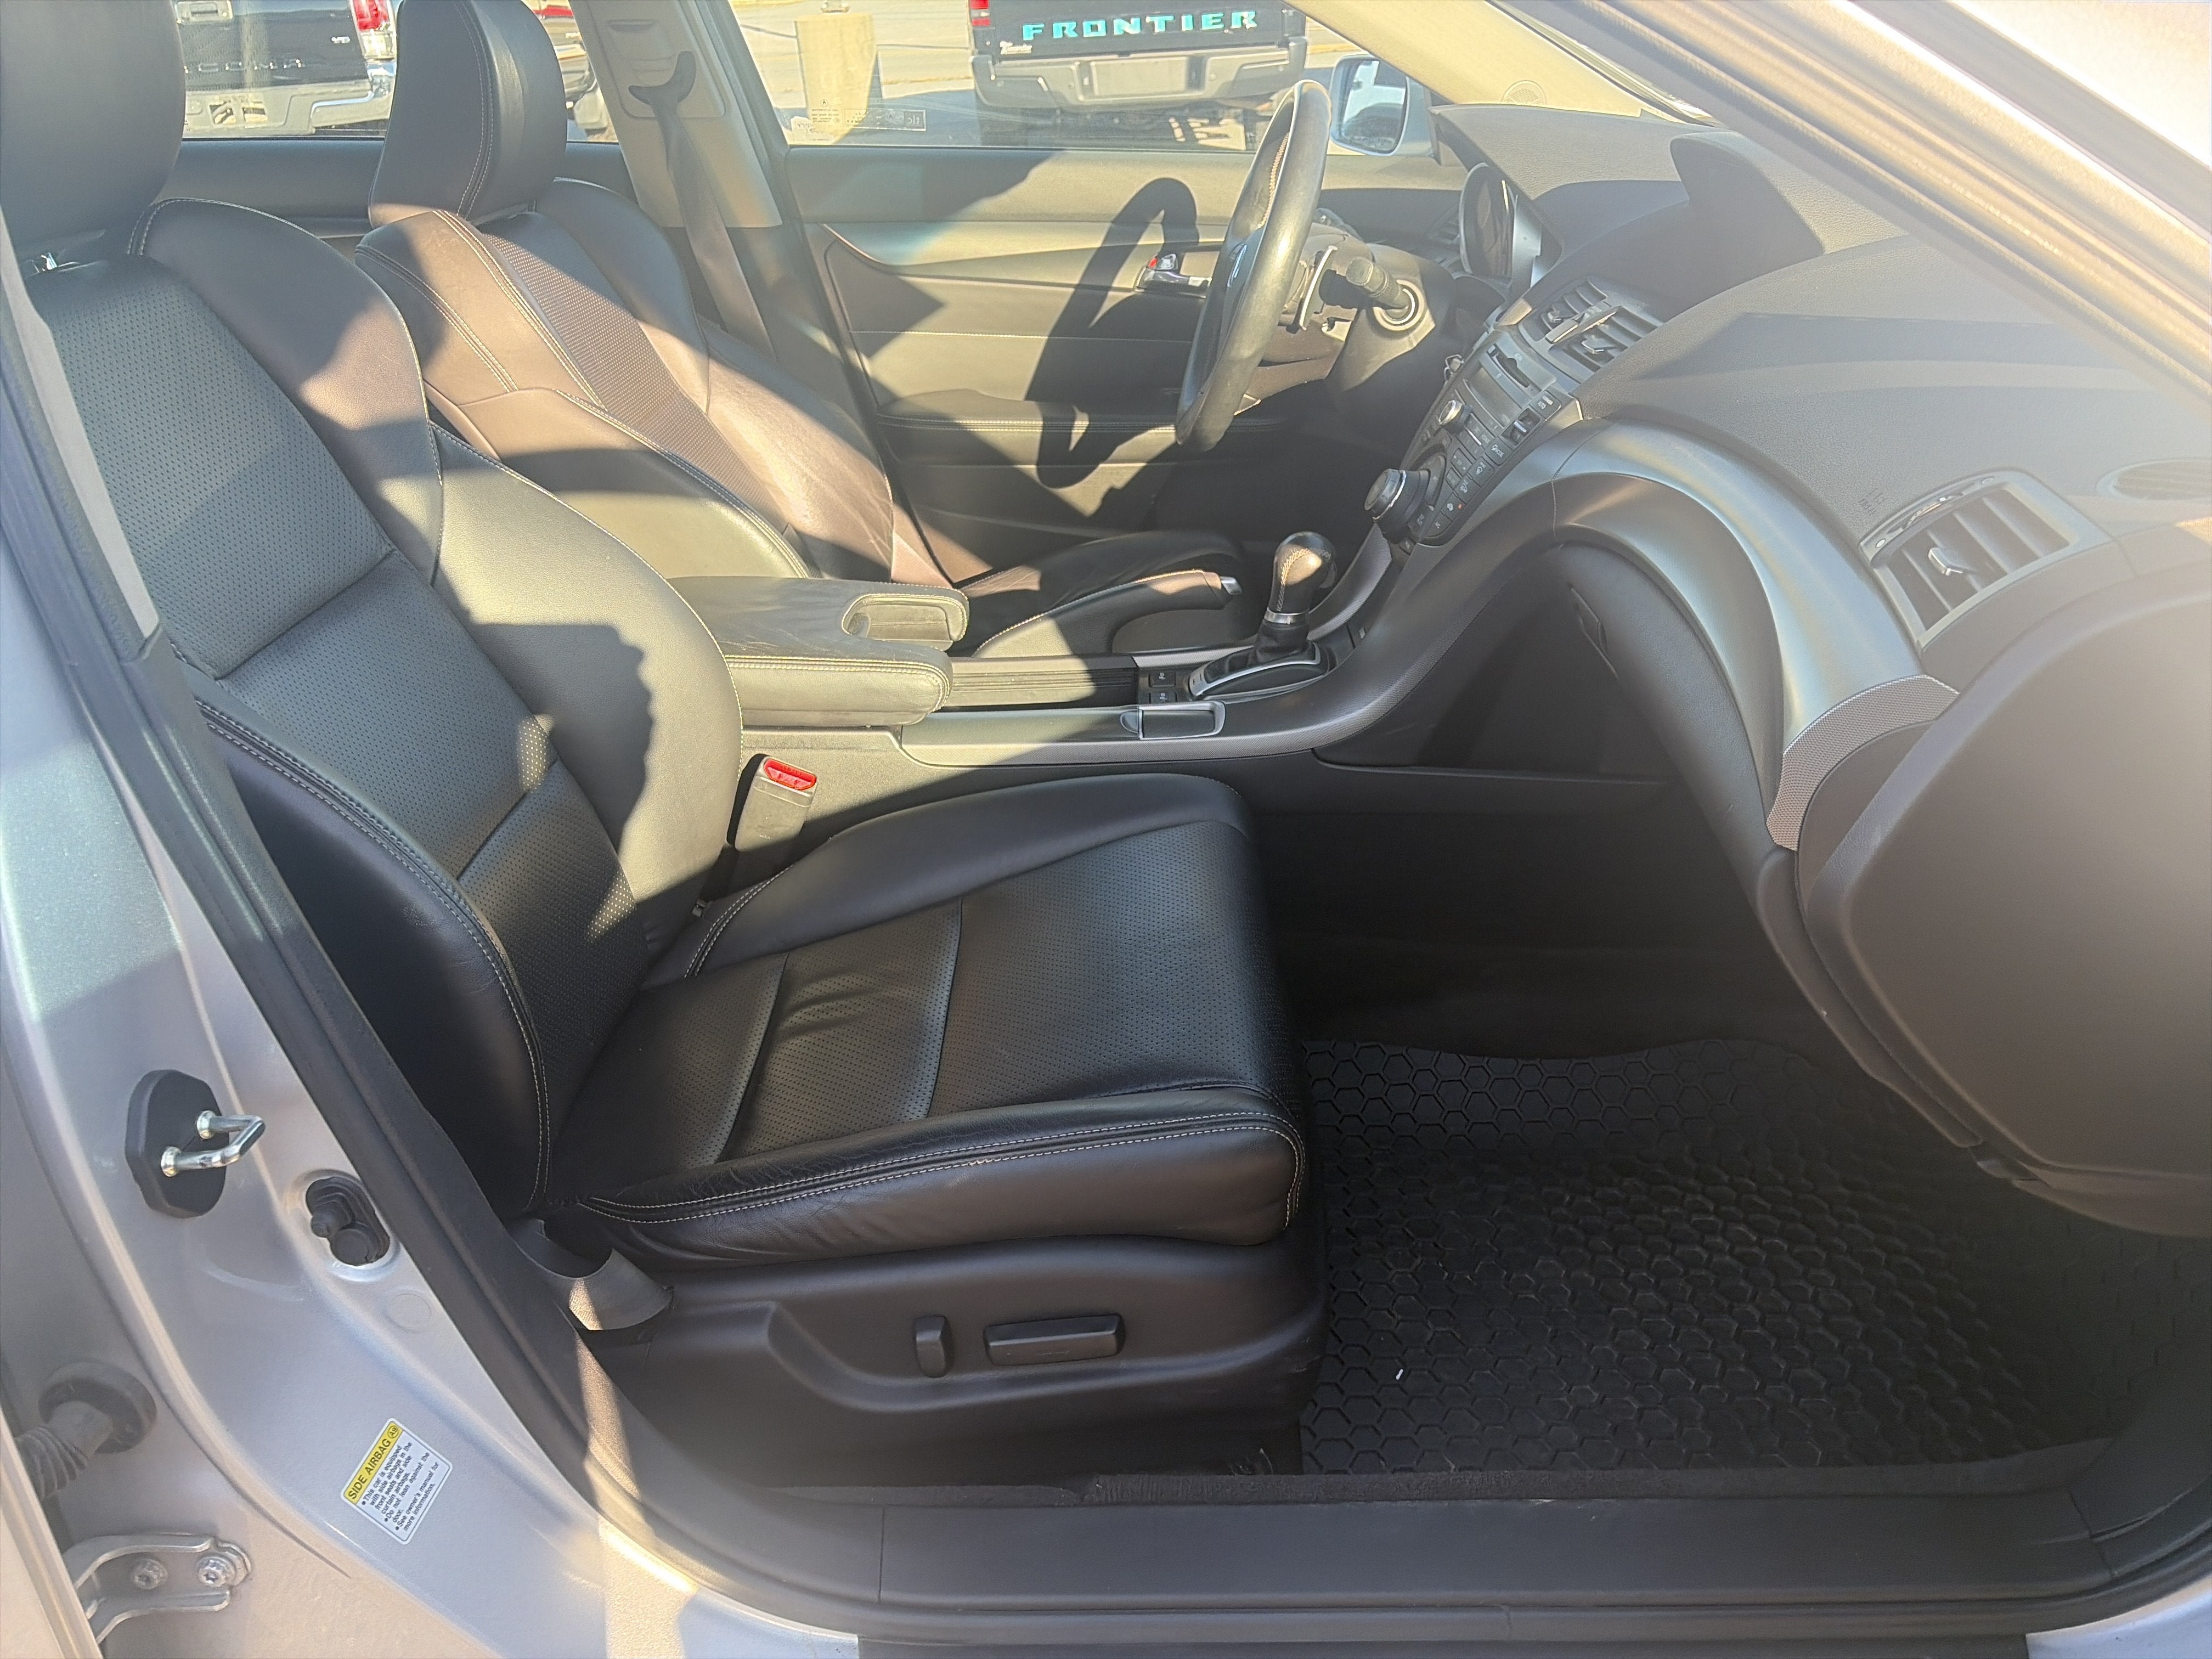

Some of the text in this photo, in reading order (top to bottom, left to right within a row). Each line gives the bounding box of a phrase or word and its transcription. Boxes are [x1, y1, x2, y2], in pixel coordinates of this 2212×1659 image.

[1023, 11, 1257, 41] FRONTIER
[348, 1475, 368, 1499] SIDE
[365, 1438, 391, 1475] AIRBAG
[363, 1489, 374, 1500] This
[385, 1445, 402, 1471] equipped
[370, 1493, 380, 1505] with
[378, 1481, 388, 1493] side
[387, 1459, 402, 1480] airbags
[403, 1442, 412, 1452] the
[375, 1455, 412, 1510] front seats and side
[381, 1473, 410, 1514] curtain airbags.
[386, 1452, 430, 1519] Do not lean against the
[392, 1509, 403, 1522] door.
[397, 1515, 407, 1527] See
[406, 1493, 421, 1514] owner's
[419, 1471, 433, 1492] manual
[403, 1484, 435, 1531] more information.
